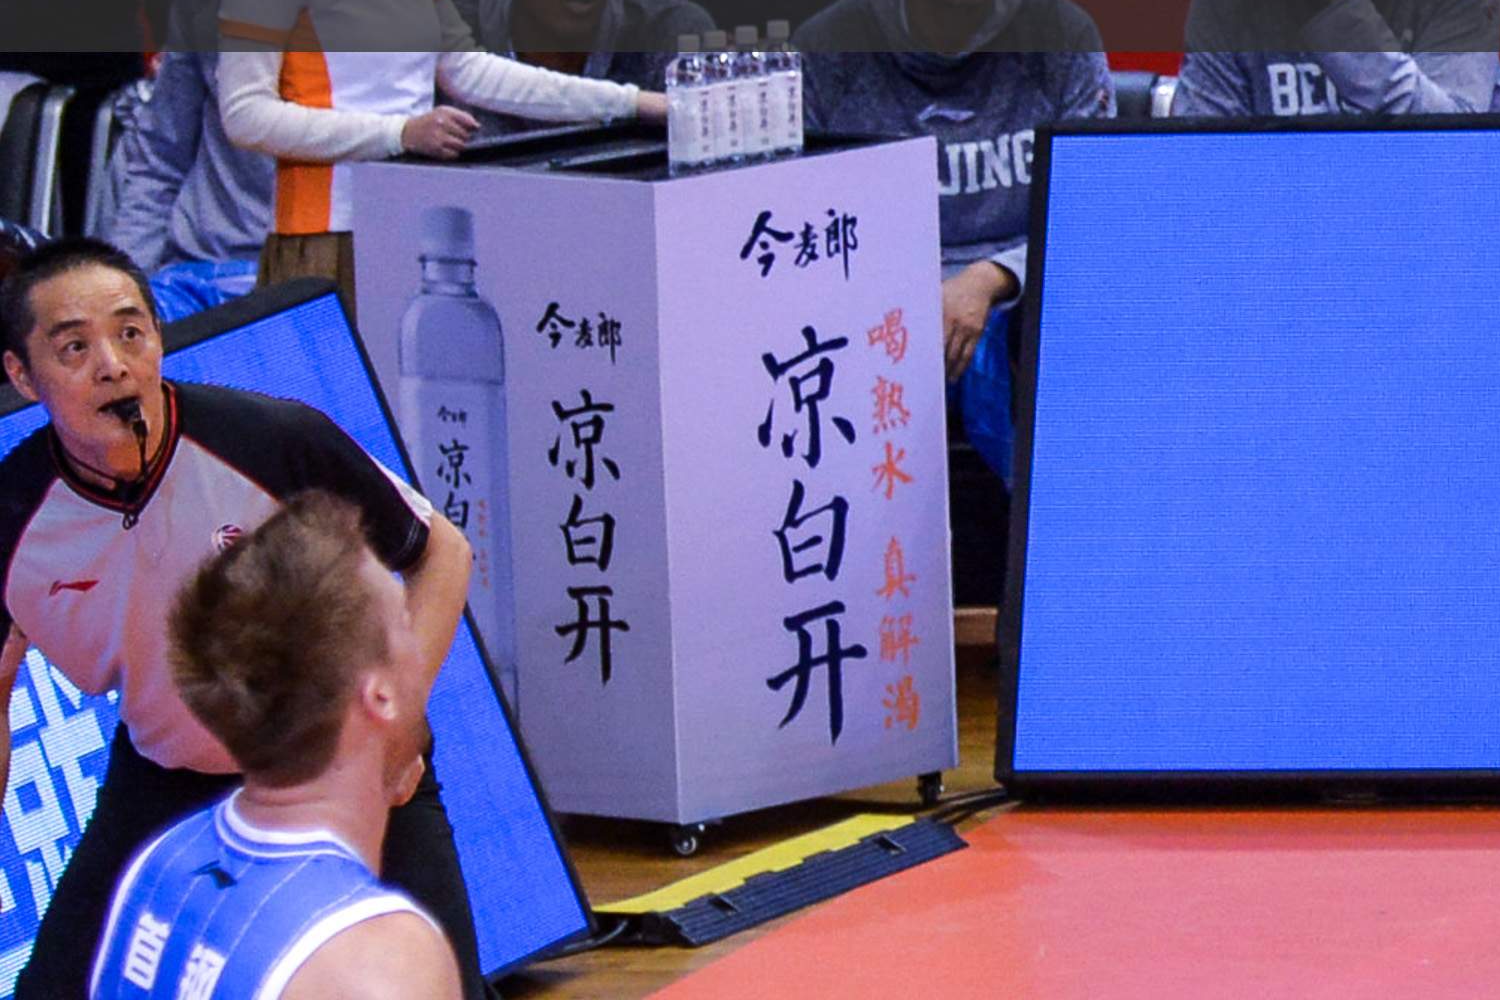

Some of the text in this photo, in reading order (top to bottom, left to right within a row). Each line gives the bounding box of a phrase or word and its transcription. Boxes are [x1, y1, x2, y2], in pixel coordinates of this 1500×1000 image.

[740, 208, 858, 280] 今麦郎
[536, 302, 622, 365] 今麦郎
[437, 438, 476, 560] 凉白
[547, 388, 631, 687] 凉白开
[757, 325, 868, 747] 凉白开
